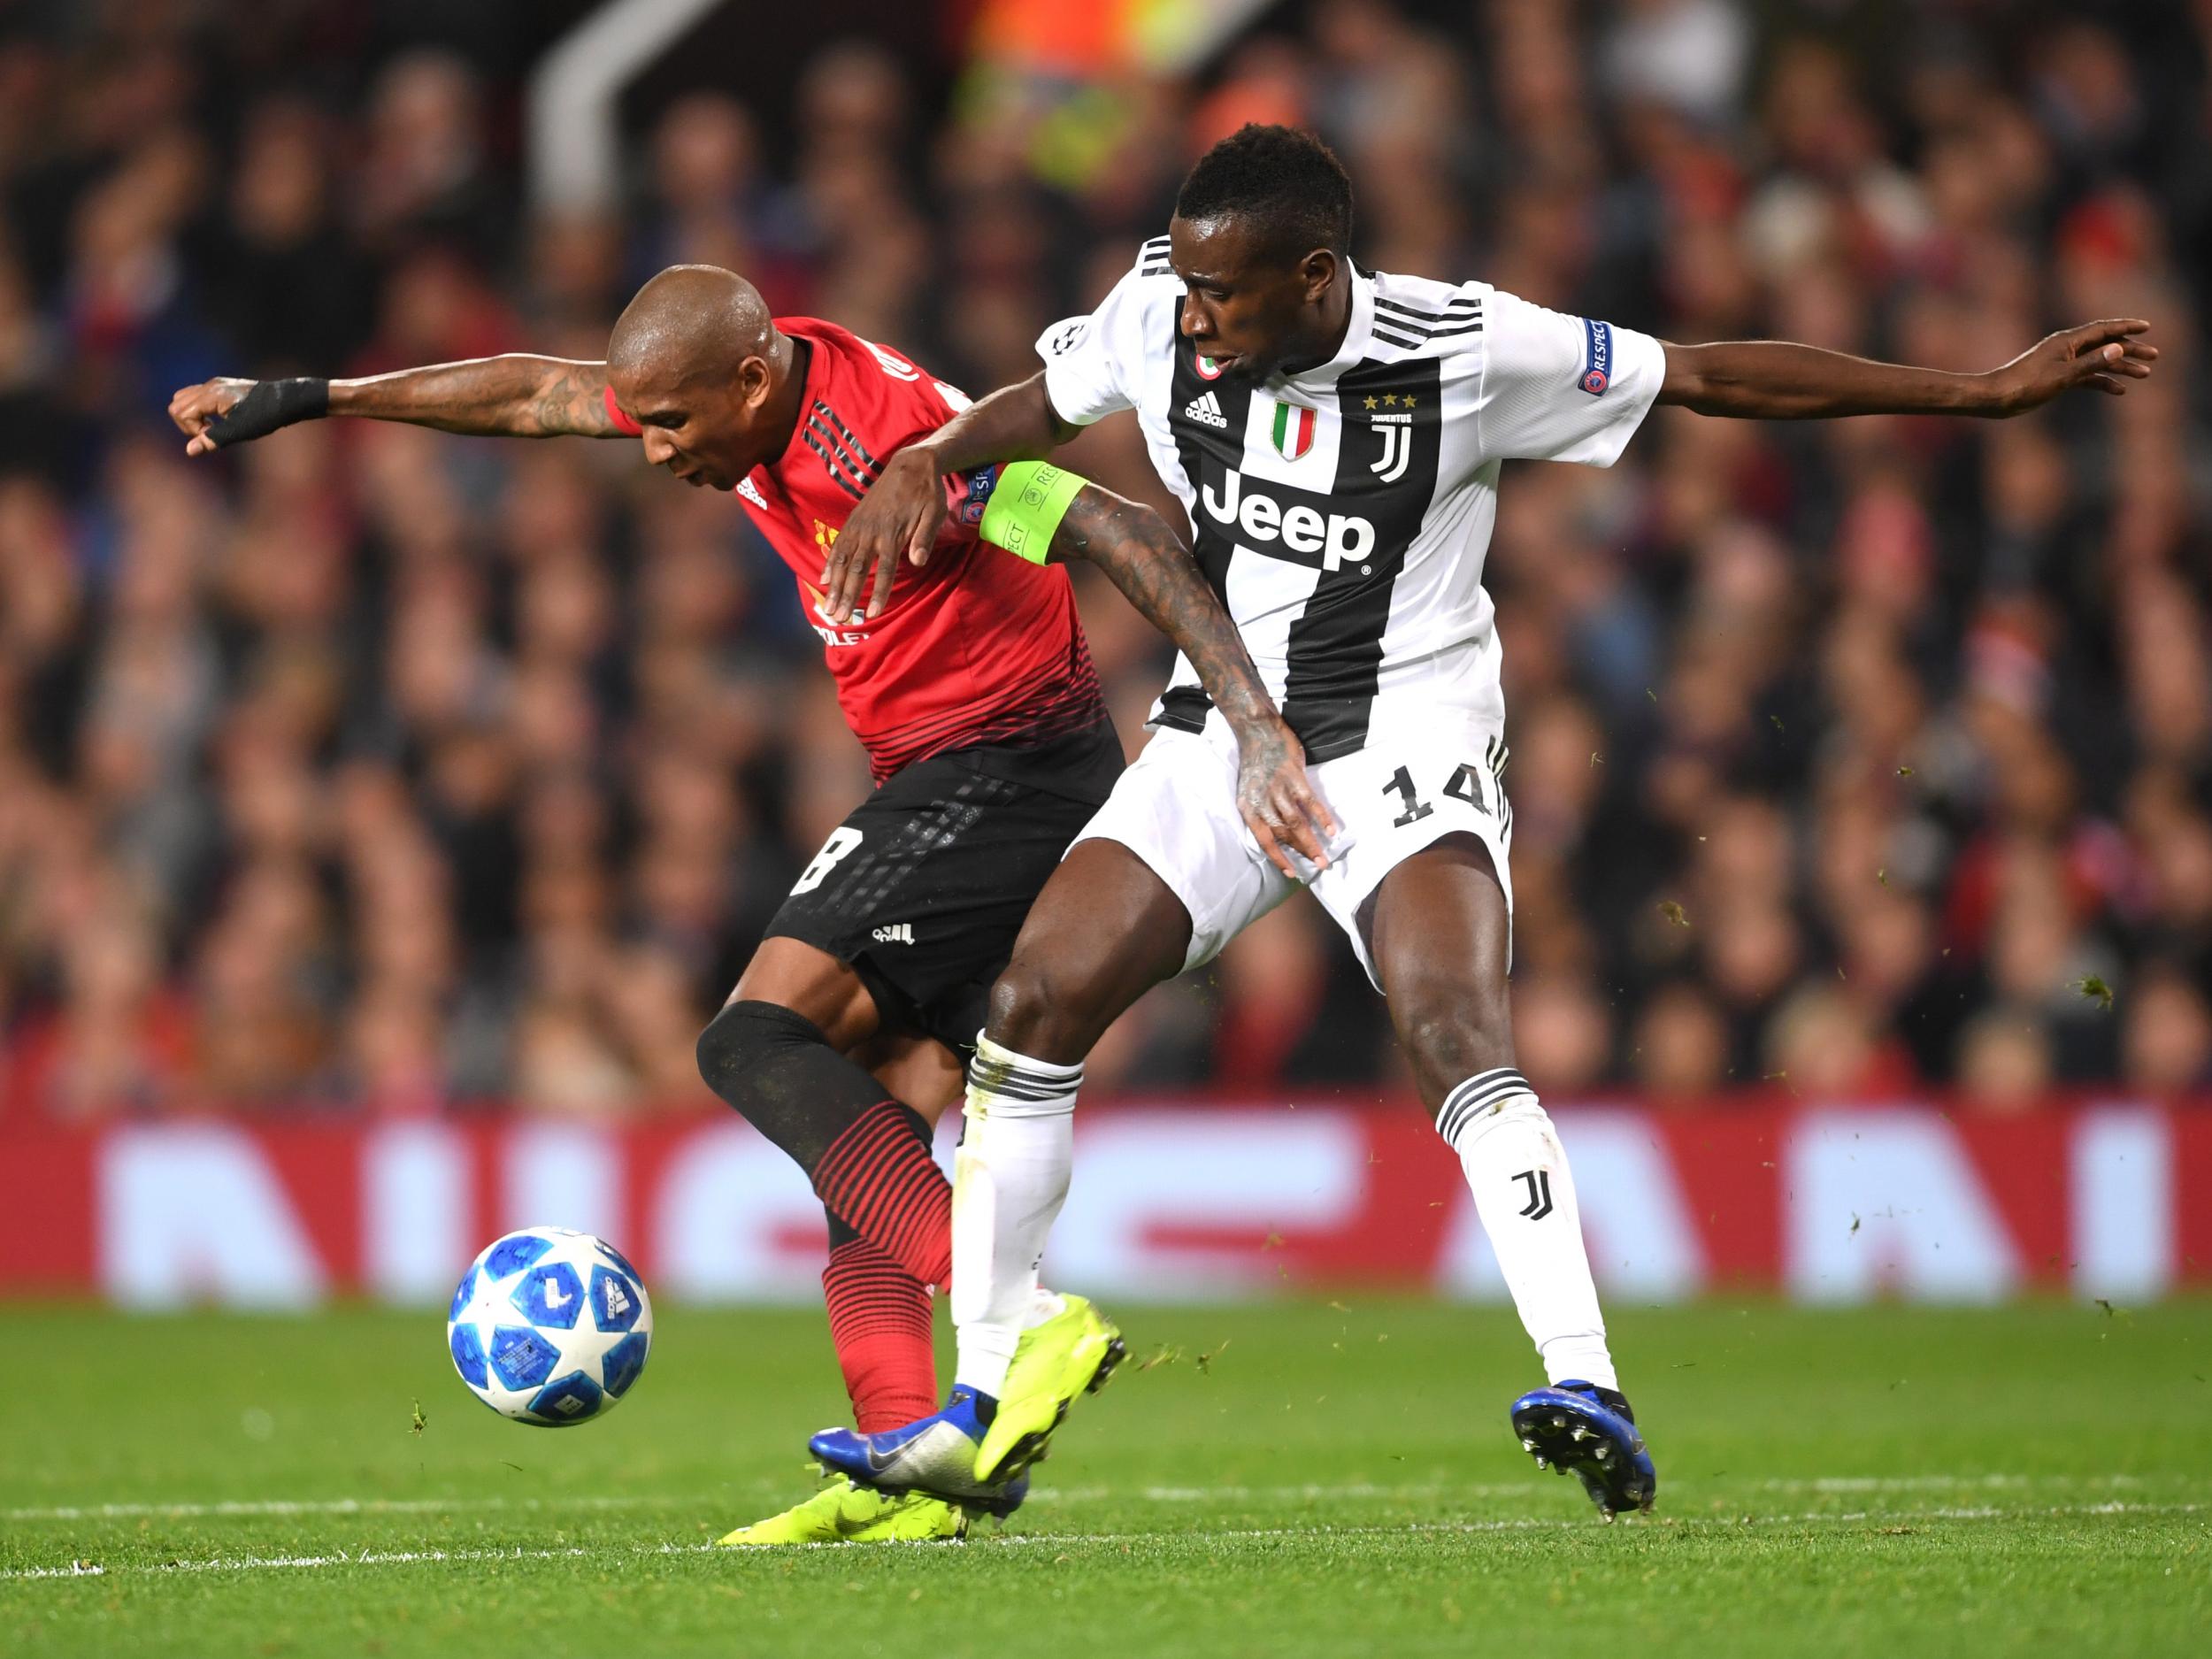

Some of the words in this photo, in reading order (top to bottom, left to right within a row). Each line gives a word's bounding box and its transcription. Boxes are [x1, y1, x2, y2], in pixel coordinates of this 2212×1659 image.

[1185, 407, 1227, 428] adidas
[1371, 413, 1412, 424] JUVENTUS
[1202, 468, 1376, 572] Jeep
[1381, 763, 1494, 829] 14
